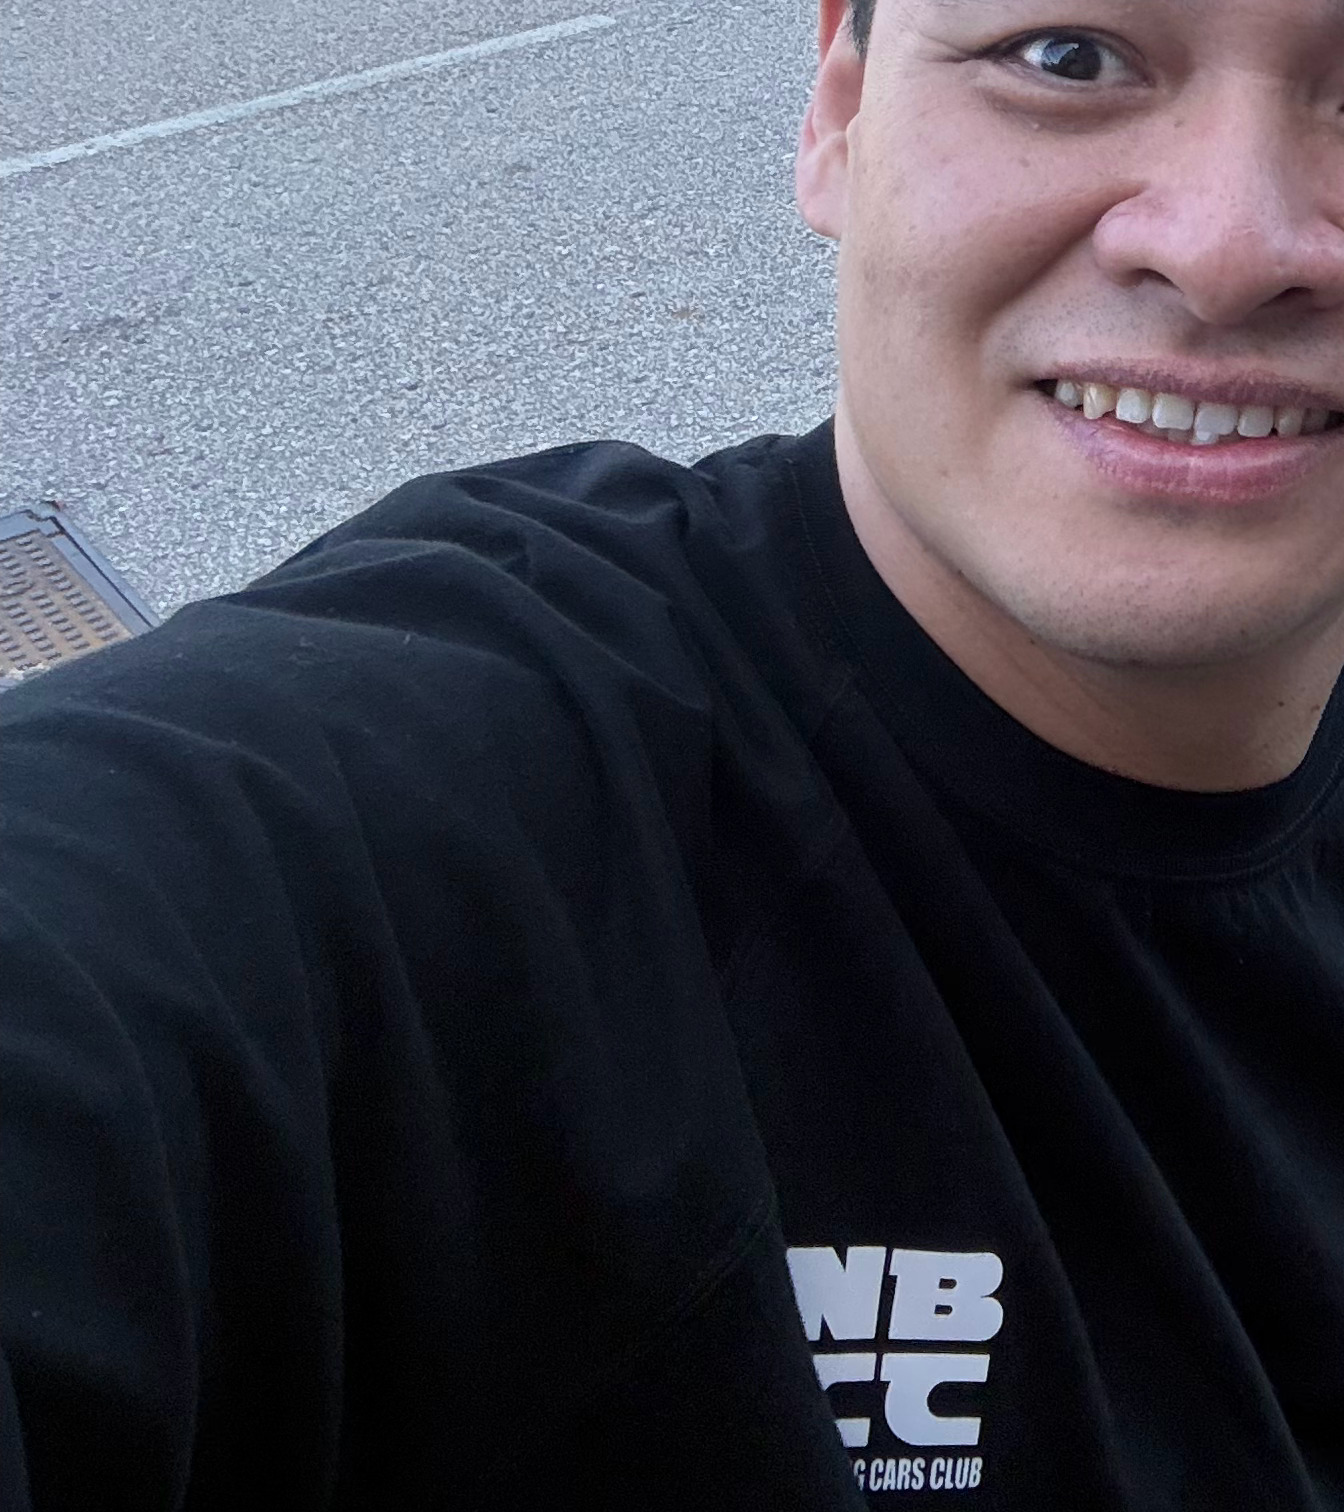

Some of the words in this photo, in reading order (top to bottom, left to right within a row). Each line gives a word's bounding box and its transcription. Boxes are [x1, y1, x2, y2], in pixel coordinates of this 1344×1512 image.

[785, 1246, 1004, 1342] NB
[869, 1457, 925, 1492] CARS
[929, 1457, 983, 1489] CLUB
